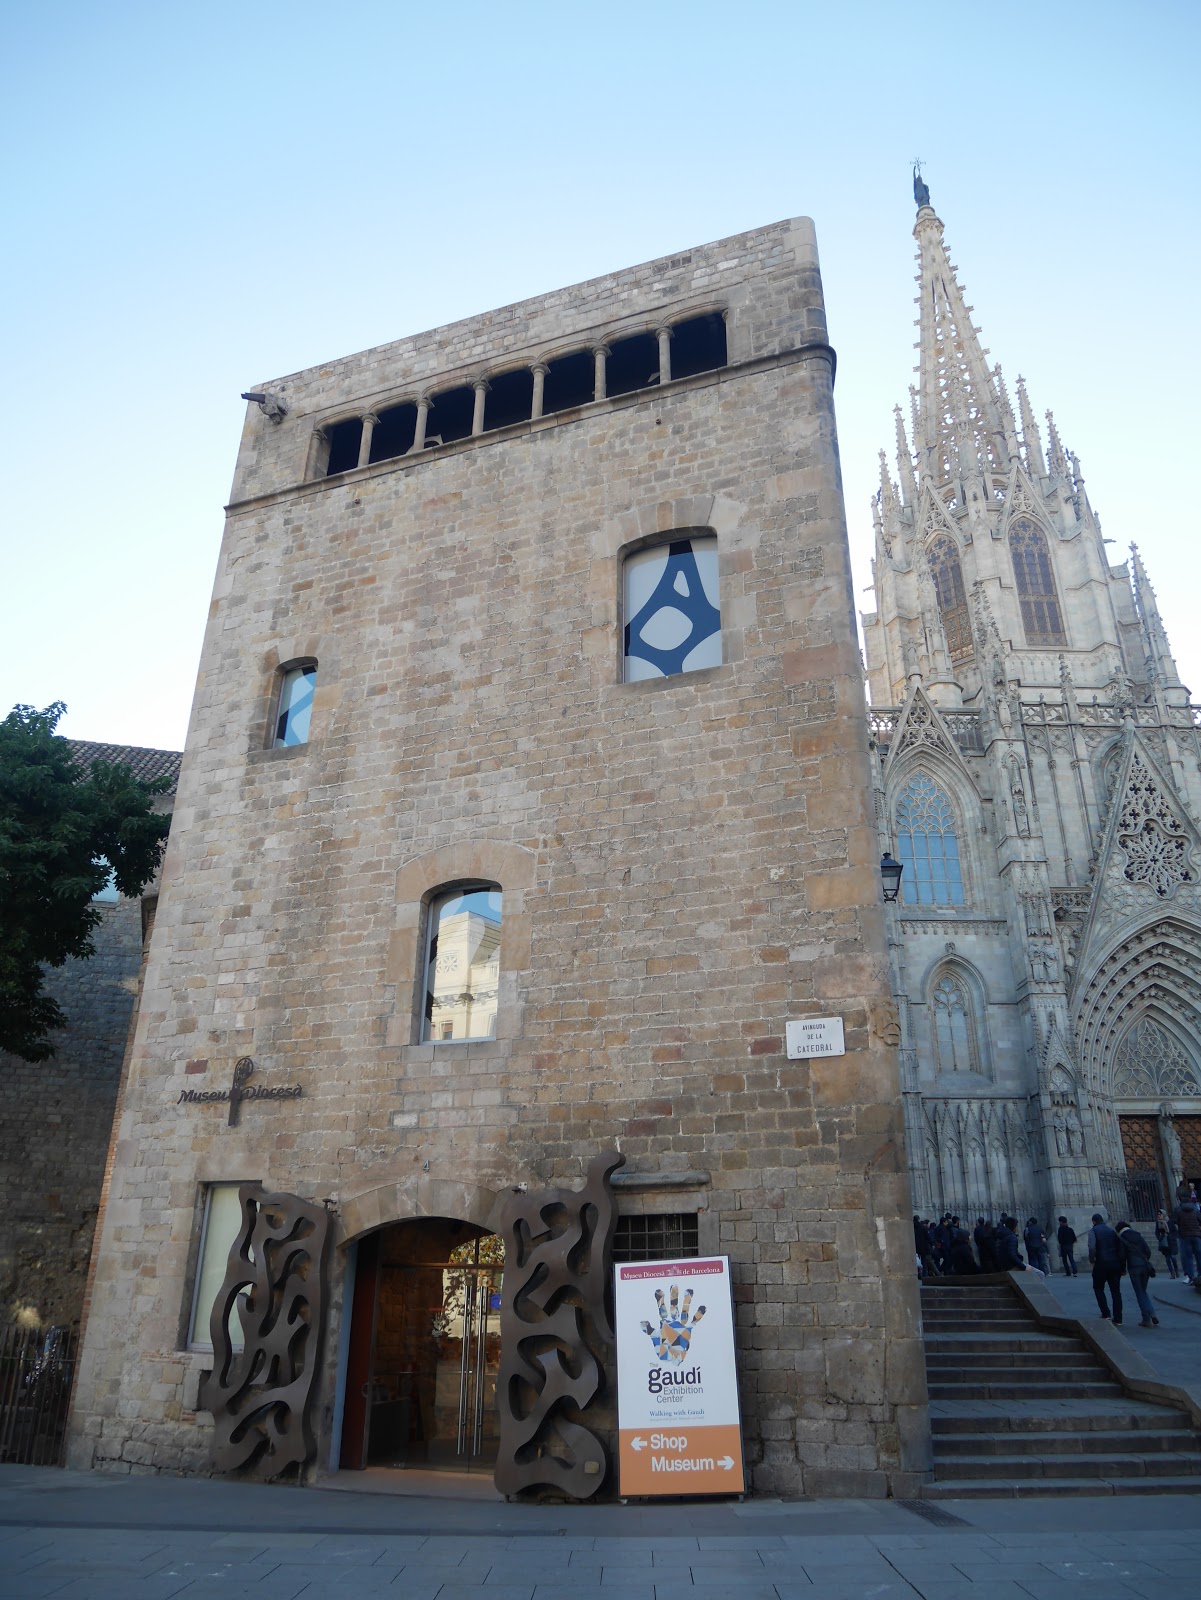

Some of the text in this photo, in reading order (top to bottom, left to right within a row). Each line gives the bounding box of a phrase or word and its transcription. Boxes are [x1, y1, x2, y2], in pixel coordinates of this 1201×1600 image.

[797, 1043, 833, 1054] CATEDRAL
[176, 1089, 231, 1105] Museu
[423, 1160, 430, 1172] 4
[691, 1267, 721, 1275] Barcelona
[648, 1366, 702, 1394] gaudí
[663, 1386, 704, 1396] Exhibition
[656, 1394, 684, 1404] Center
[650, 1434, 688, 1452] Shop
[651, 1456, 715, 1472] Museum
